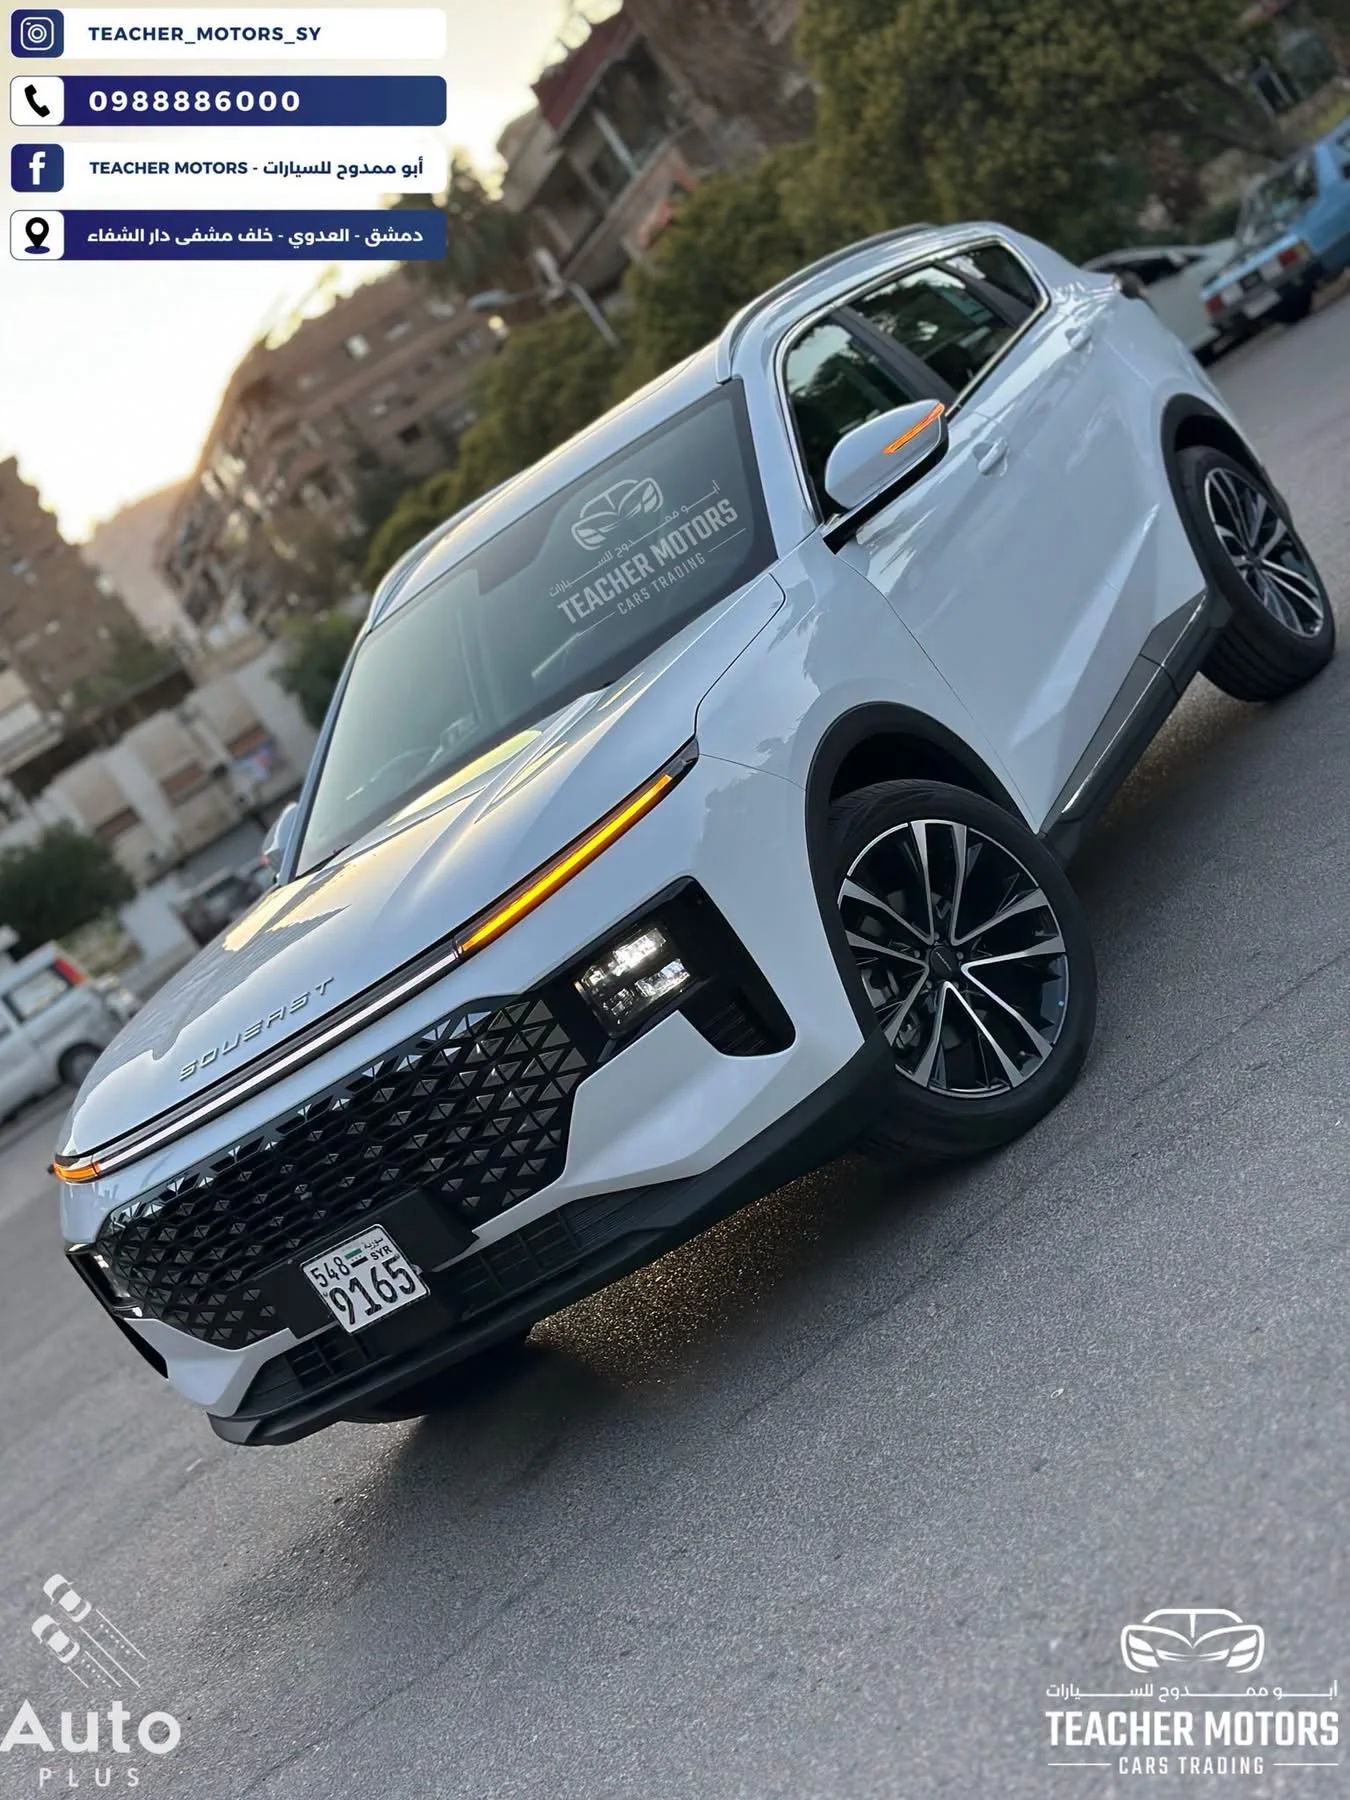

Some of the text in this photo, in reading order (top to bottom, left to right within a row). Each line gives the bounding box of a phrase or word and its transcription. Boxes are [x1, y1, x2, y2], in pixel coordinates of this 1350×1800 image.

[557, 498, 739, 624] TEACHER MOTORS
[617, 552, 707, 615] CARS TRADING
[179, 976, 335, 1082] SOUEAST
[310, 1245, 393, 1288] 548 SYR
[329, 1256, 416, 1325] 9165
